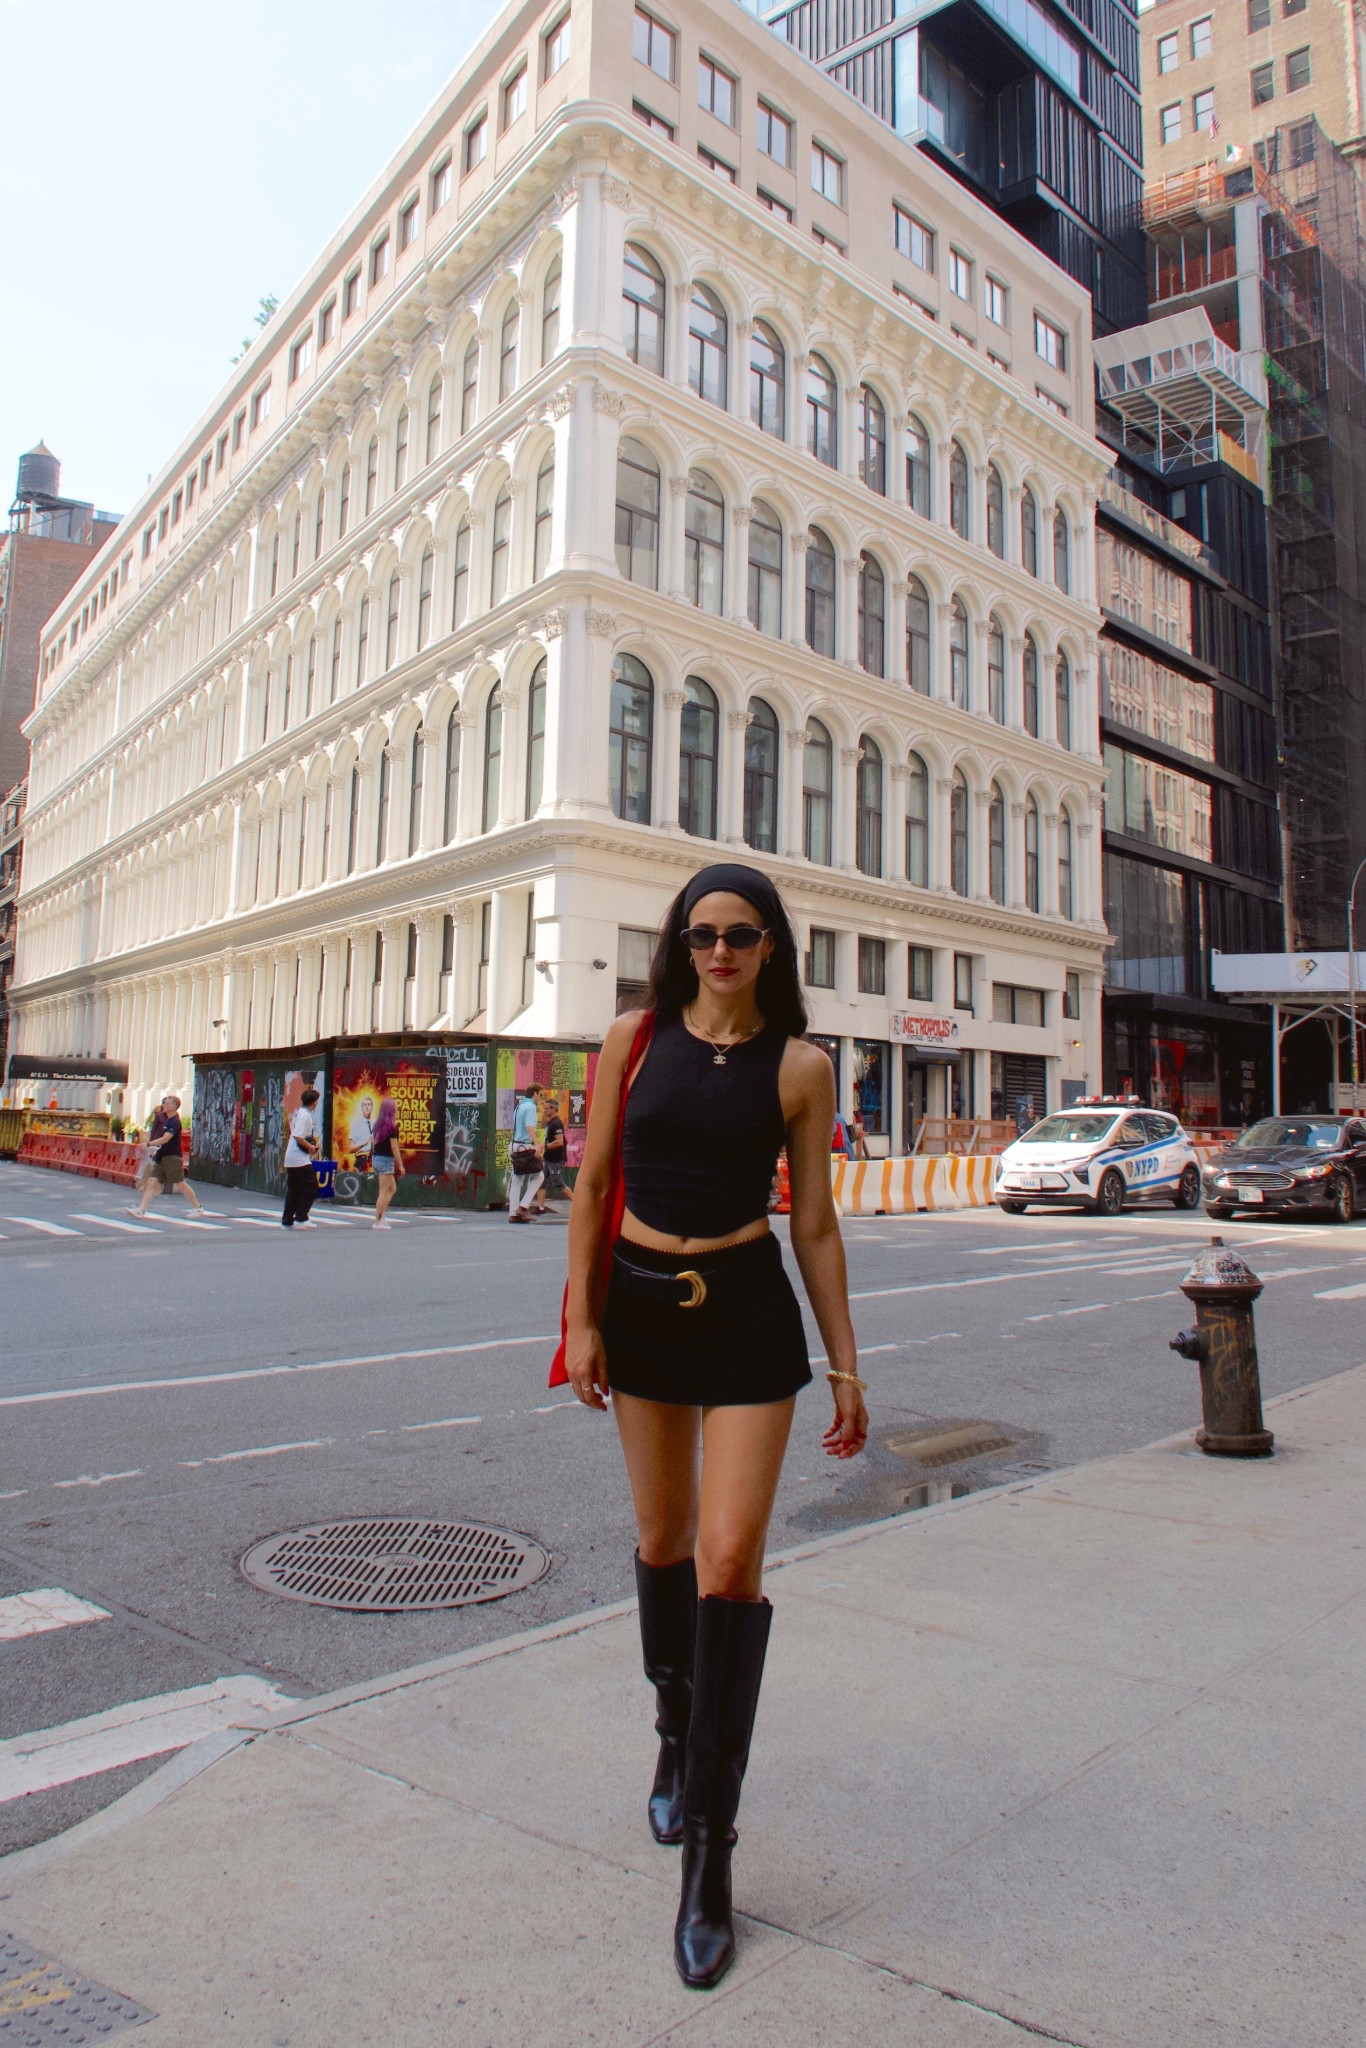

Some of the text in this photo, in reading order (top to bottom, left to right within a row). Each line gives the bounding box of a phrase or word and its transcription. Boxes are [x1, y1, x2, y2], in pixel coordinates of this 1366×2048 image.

[903, 1016, 950, 1038] METROPOLIS
[1240, 1060, 1255, 1069] SPACE
[446, 1066, 484, 1077] SIDEWALK
[1242, 1070, 1253, 1078] FOR
[386, 1077, 438, 1087] FROM THE CREATORS OF
[446, 1077, 484, 1090] CLOSED
[1241, 1080, 1255, 1088] LEASE
[390, 1086, 433, 1099] SOUTH
[394, 1098, 428, 1111] PARK
[400, 1110, 412, 1120] EGOT
[412, 1110, 431, 1120] WINNER
[395, 1119, 437, 1133] OBERT
[398, 1131, 431, 1145] OPEZ
[1134, 1157, 1159, 1177] NYPD
